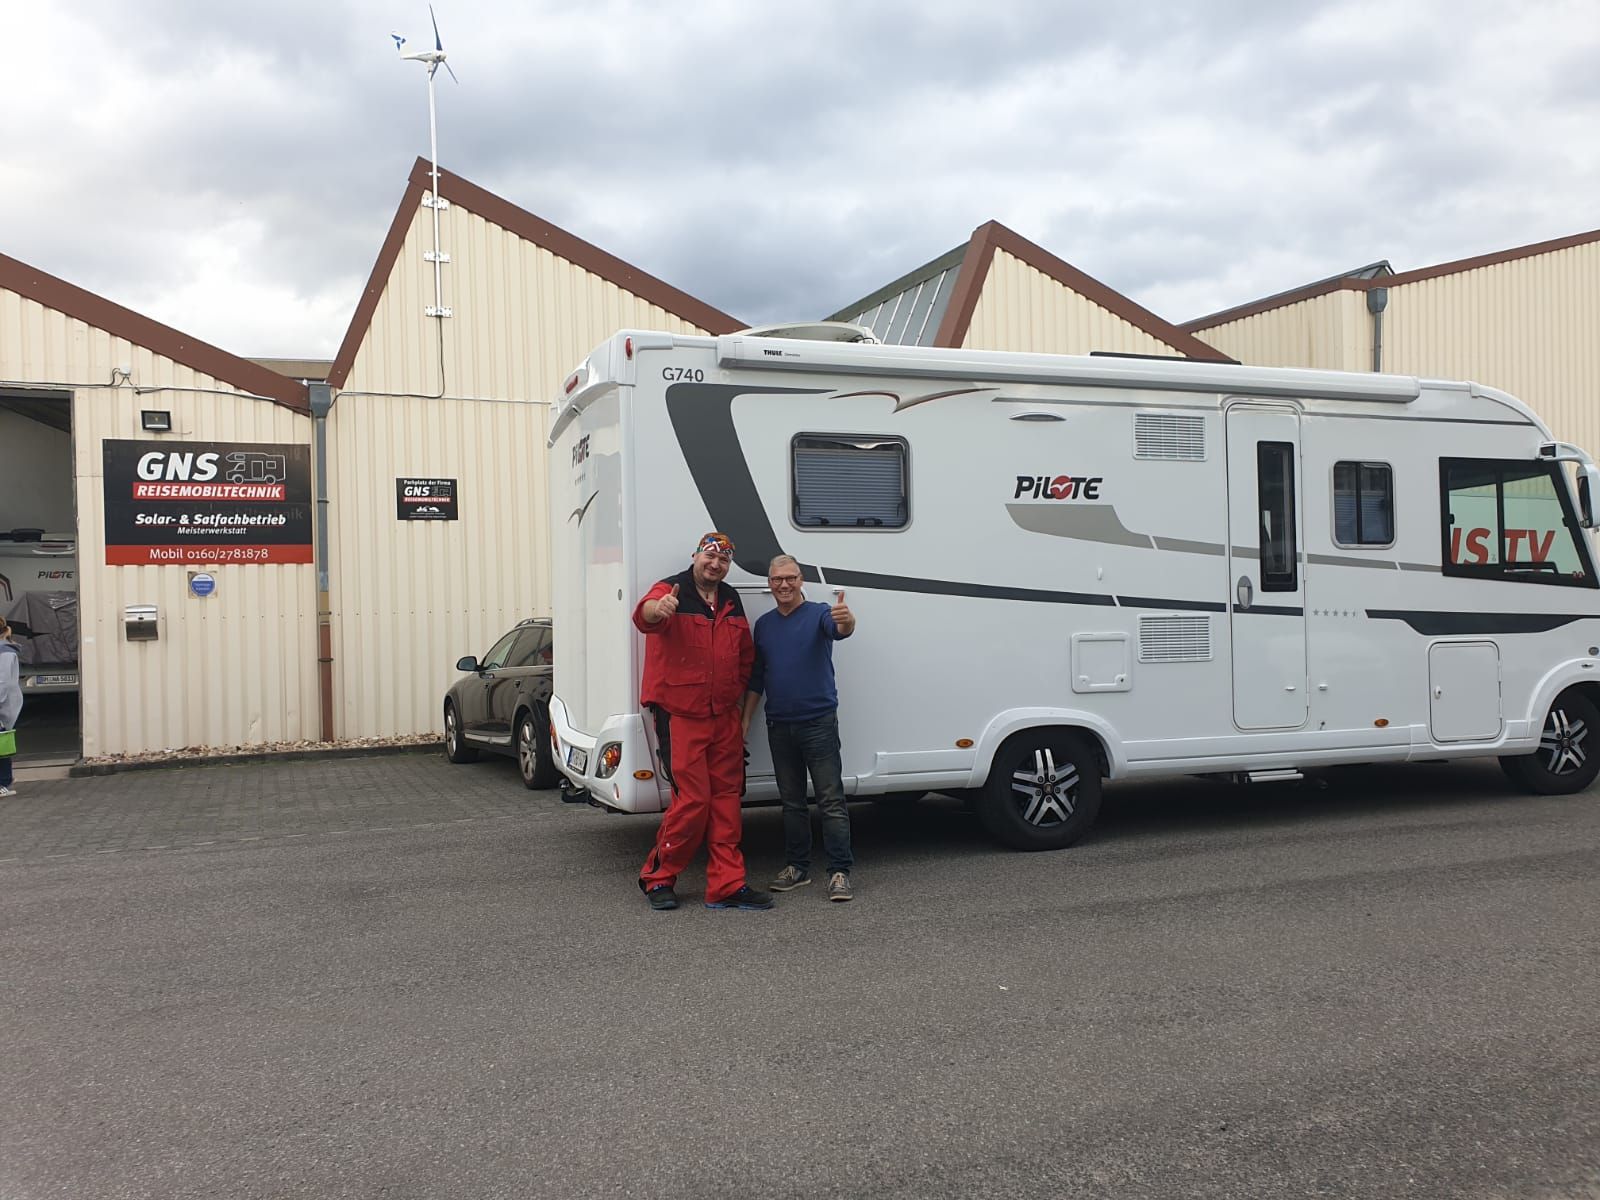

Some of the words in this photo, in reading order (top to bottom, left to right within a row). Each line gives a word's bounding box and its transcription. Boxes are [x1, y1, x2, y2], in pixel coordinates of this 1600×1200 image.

[662, 367, 705, 383] G740
[136, 452, 220, 481] GNS
[136, 485, 282, 498] REISEMOBILTECHNIK
[404, 486, 430, 496] GNS
[135, 513, 177, 525] Solar-
[179, 514, 189, 525] &
[193, 513, 286, 527] Satfachbetrieb
[176, 526, 247, 535] Meisterwerkstatt
[149, 549, 183, 560] Mobil
[187, 549, 269, 560] 0160/2781878
